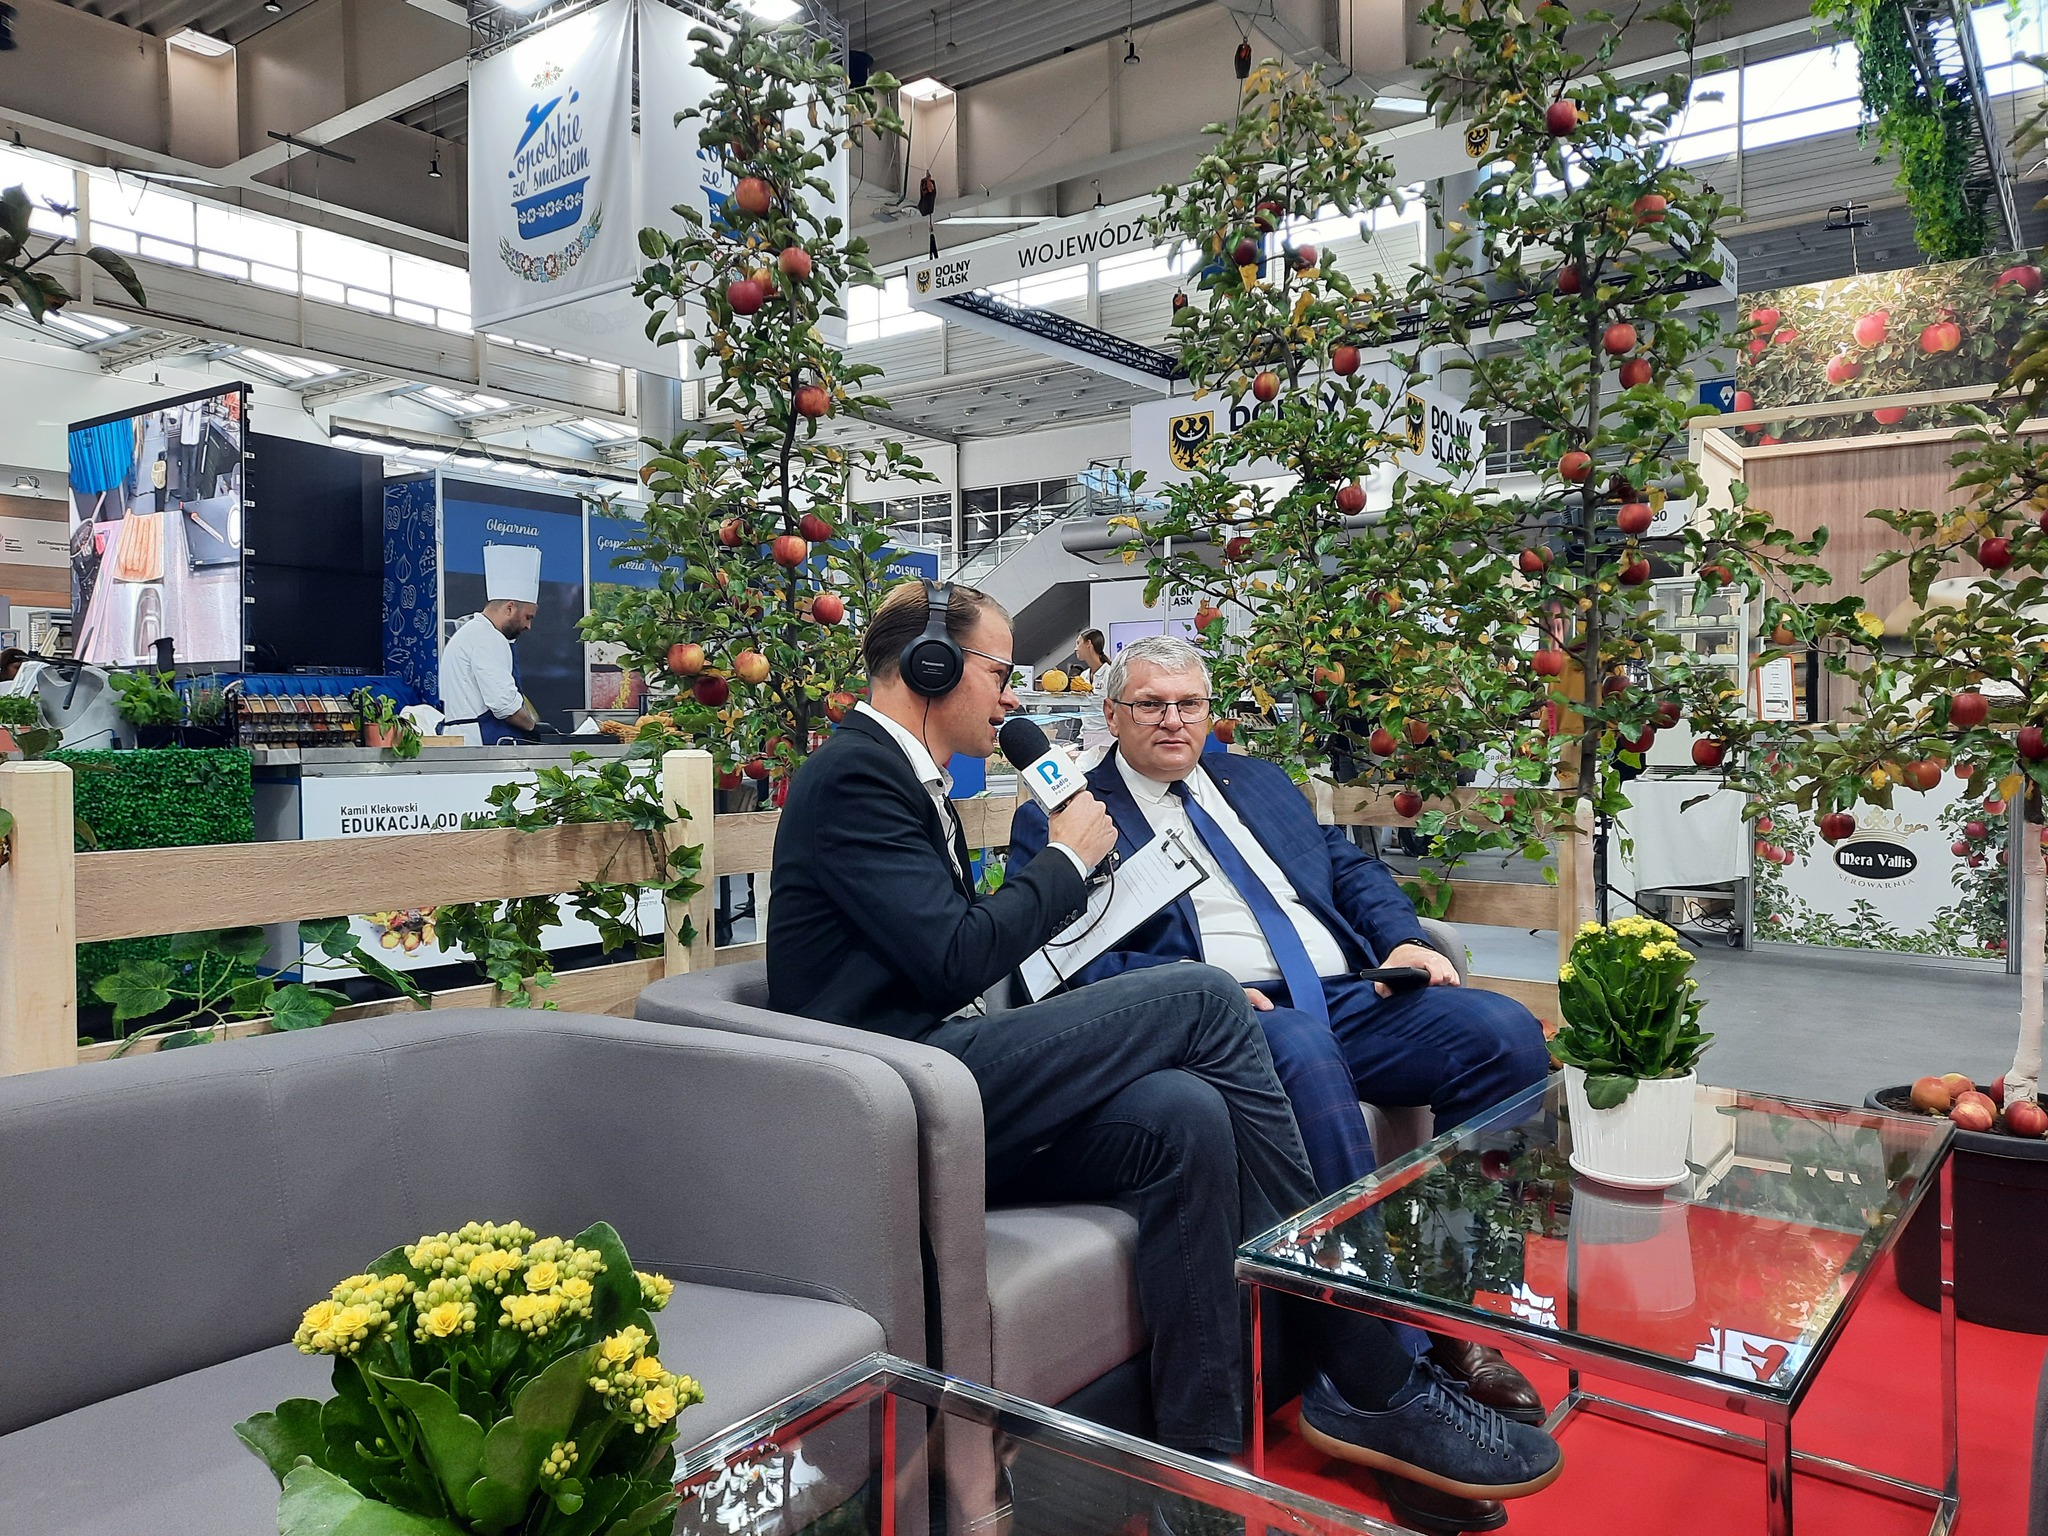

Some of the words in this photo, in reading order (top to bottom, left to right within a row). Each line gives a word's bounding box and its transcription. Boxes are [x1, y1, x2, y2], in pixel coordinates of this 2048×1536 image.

[517, 112, 583, 182] opolskie
[533, 146, 590, 191] smakiem
[935, 259, 971, 277] DOLNY
[486, 518, 540, 536] Olejarnia
[340, 804, 368, 816] Kamil
[370, 802, 418, 815] Klekowski
[341, 814, 431, 834] EDUKACJA
[437, 812, 458, 828] OD
[1840, 851, 1873, 866] Mera
[1877, 853, 1912, 868] Vallis
